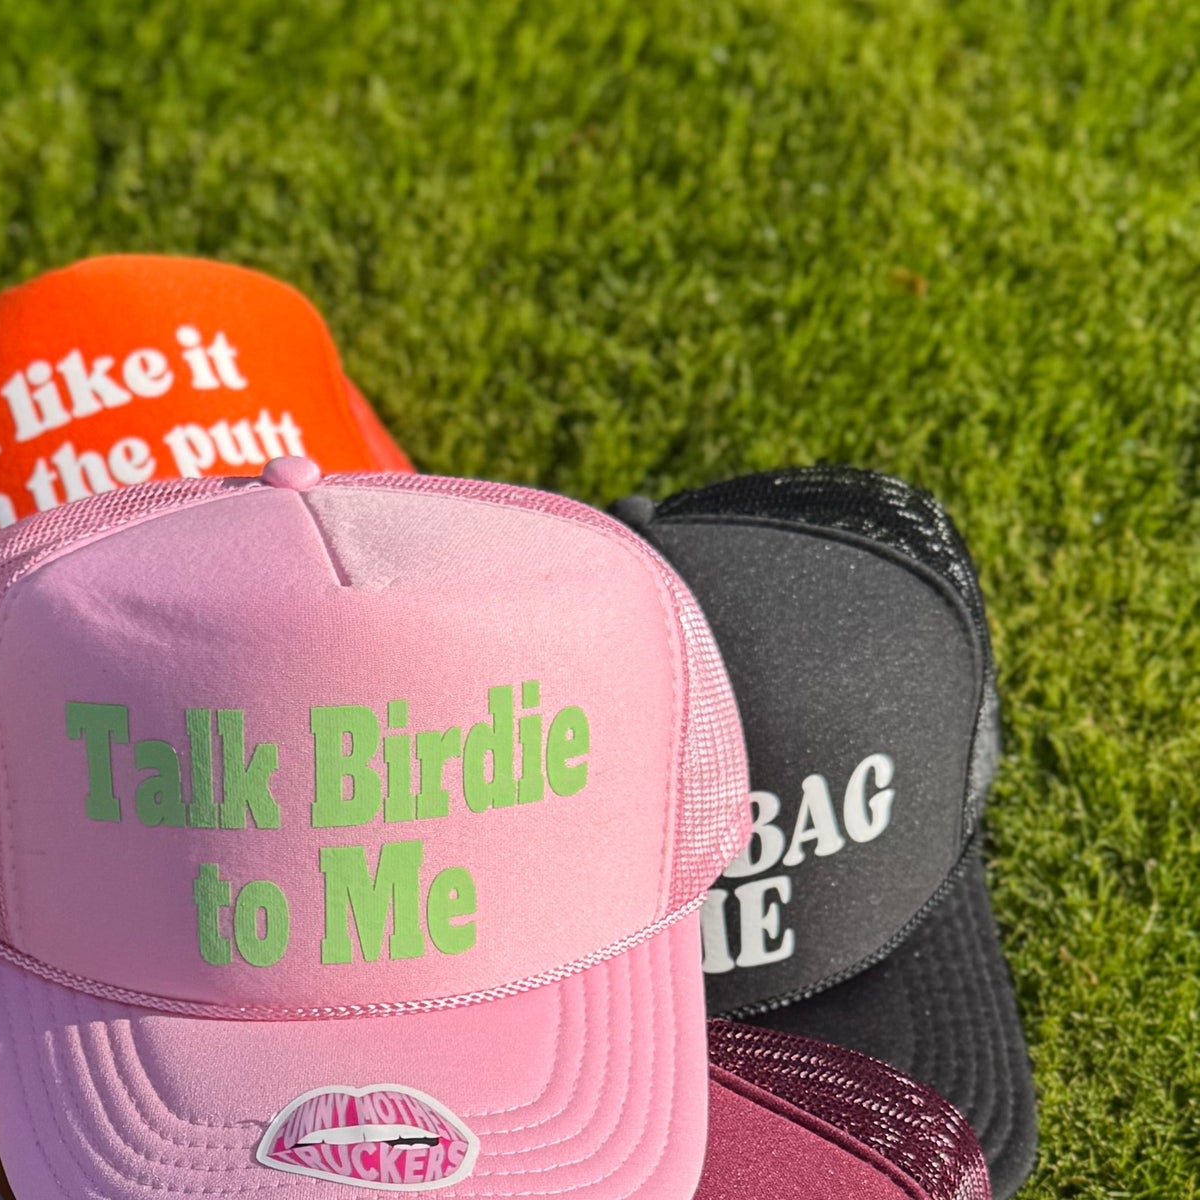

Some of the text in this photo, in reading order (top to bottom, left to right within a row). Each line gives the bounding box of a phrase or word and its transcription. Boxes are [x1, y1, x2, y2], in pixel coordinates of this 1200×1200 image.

[0, 348, 174, 445] like
[176, 324, 248, 391] it
[25, 437, 157, 504] the
[162, 409, 304, 479] putt
[65, 679, 590, 830] Talk Birdie
[721, 752, 896, 878] BAG
[192, 840, 477, 967] to Me
